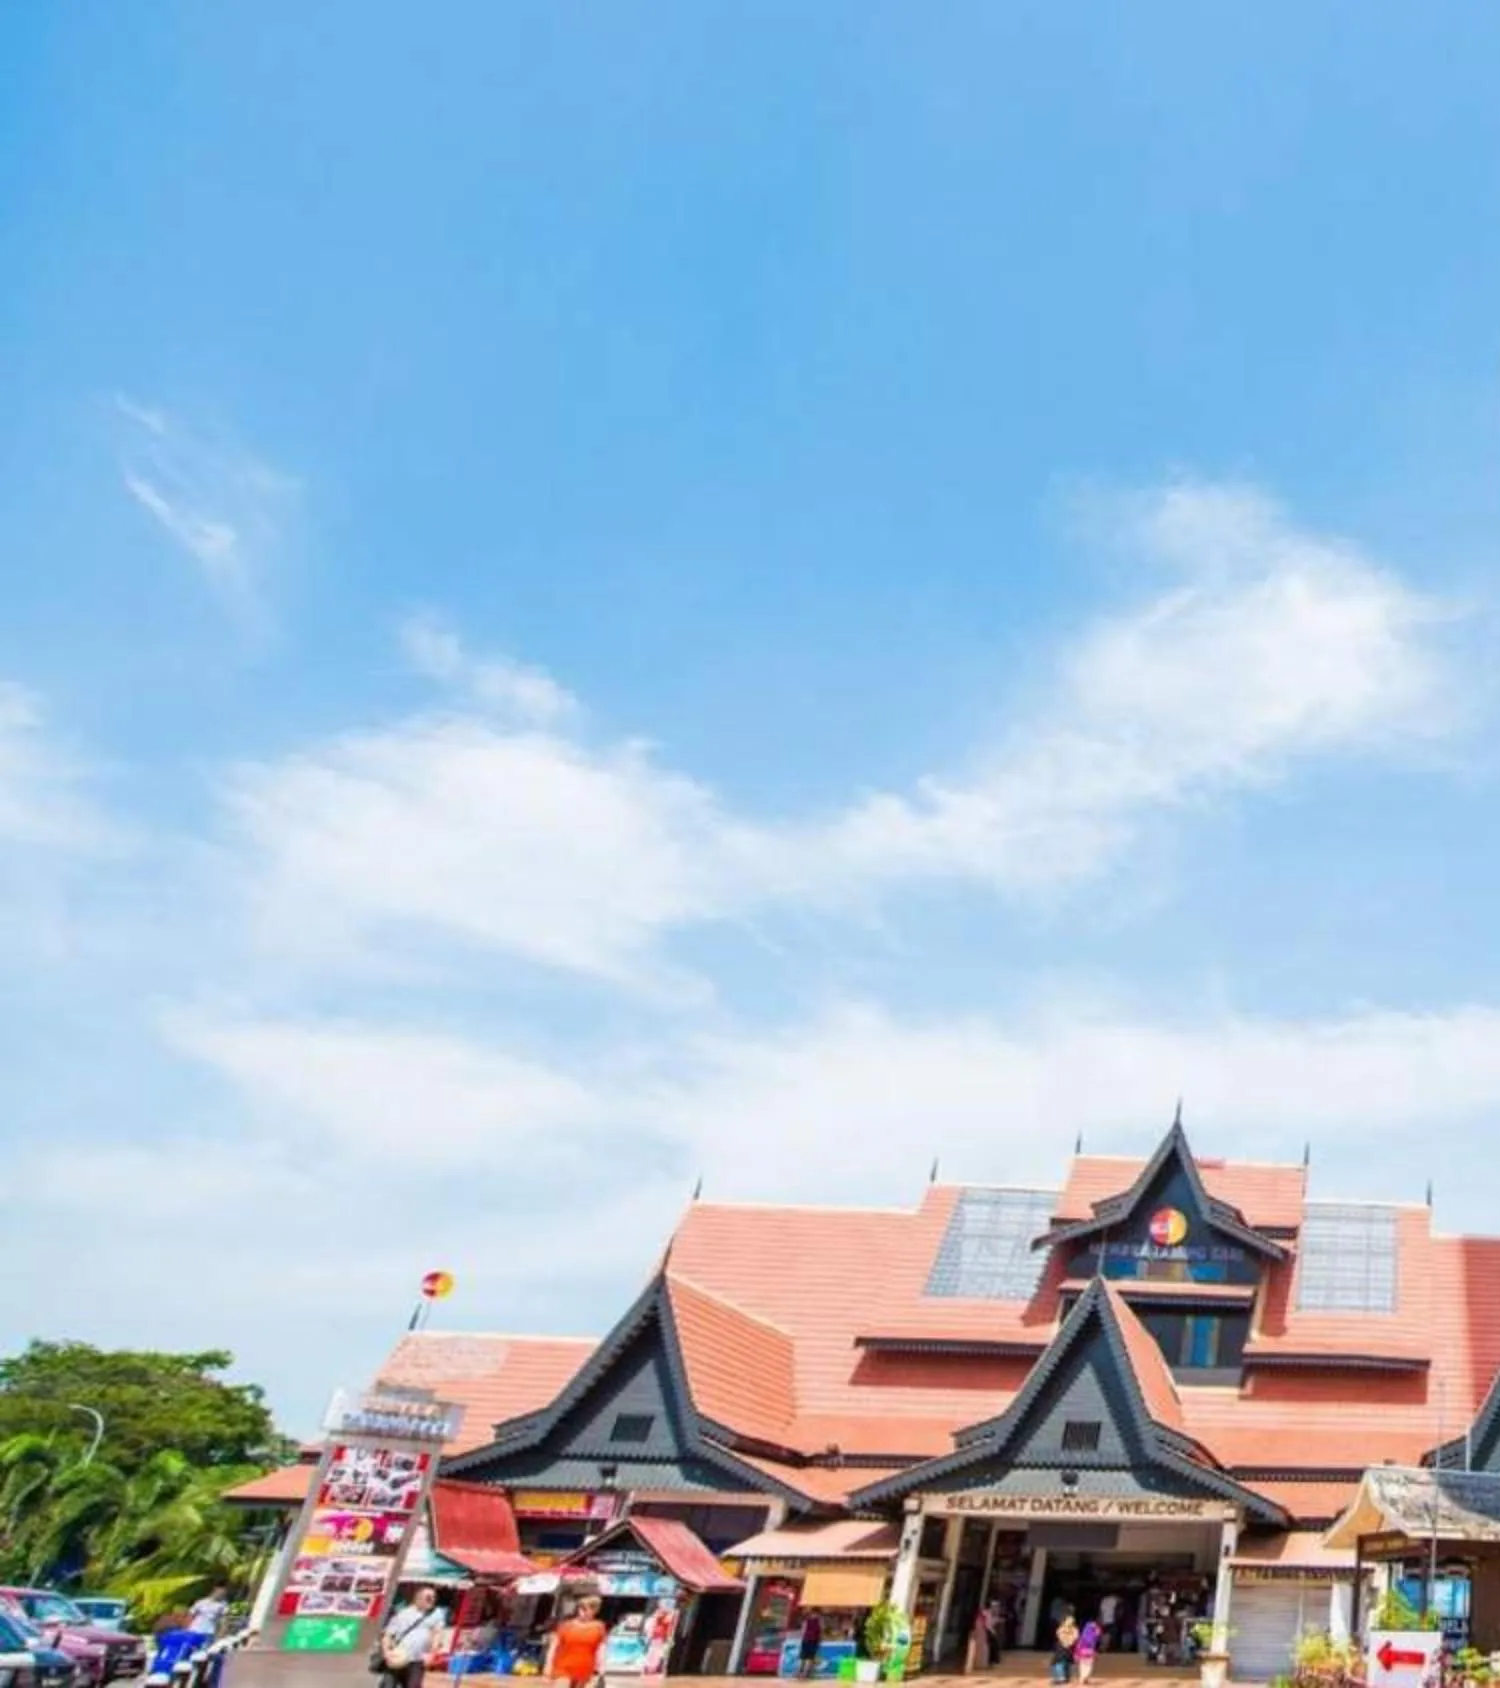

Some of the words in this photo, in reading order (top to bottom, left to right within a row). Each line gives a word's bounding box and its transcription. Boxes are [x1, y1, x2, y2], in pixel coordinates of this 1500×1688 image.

[945, 1496, 1028, 1511] SELAMAT
[1031, 1498, 1099, 1512] DATANG
[1102, 1501, 1113, 1513] /
[1117, 1501, 1204, 1515] WELCOME
